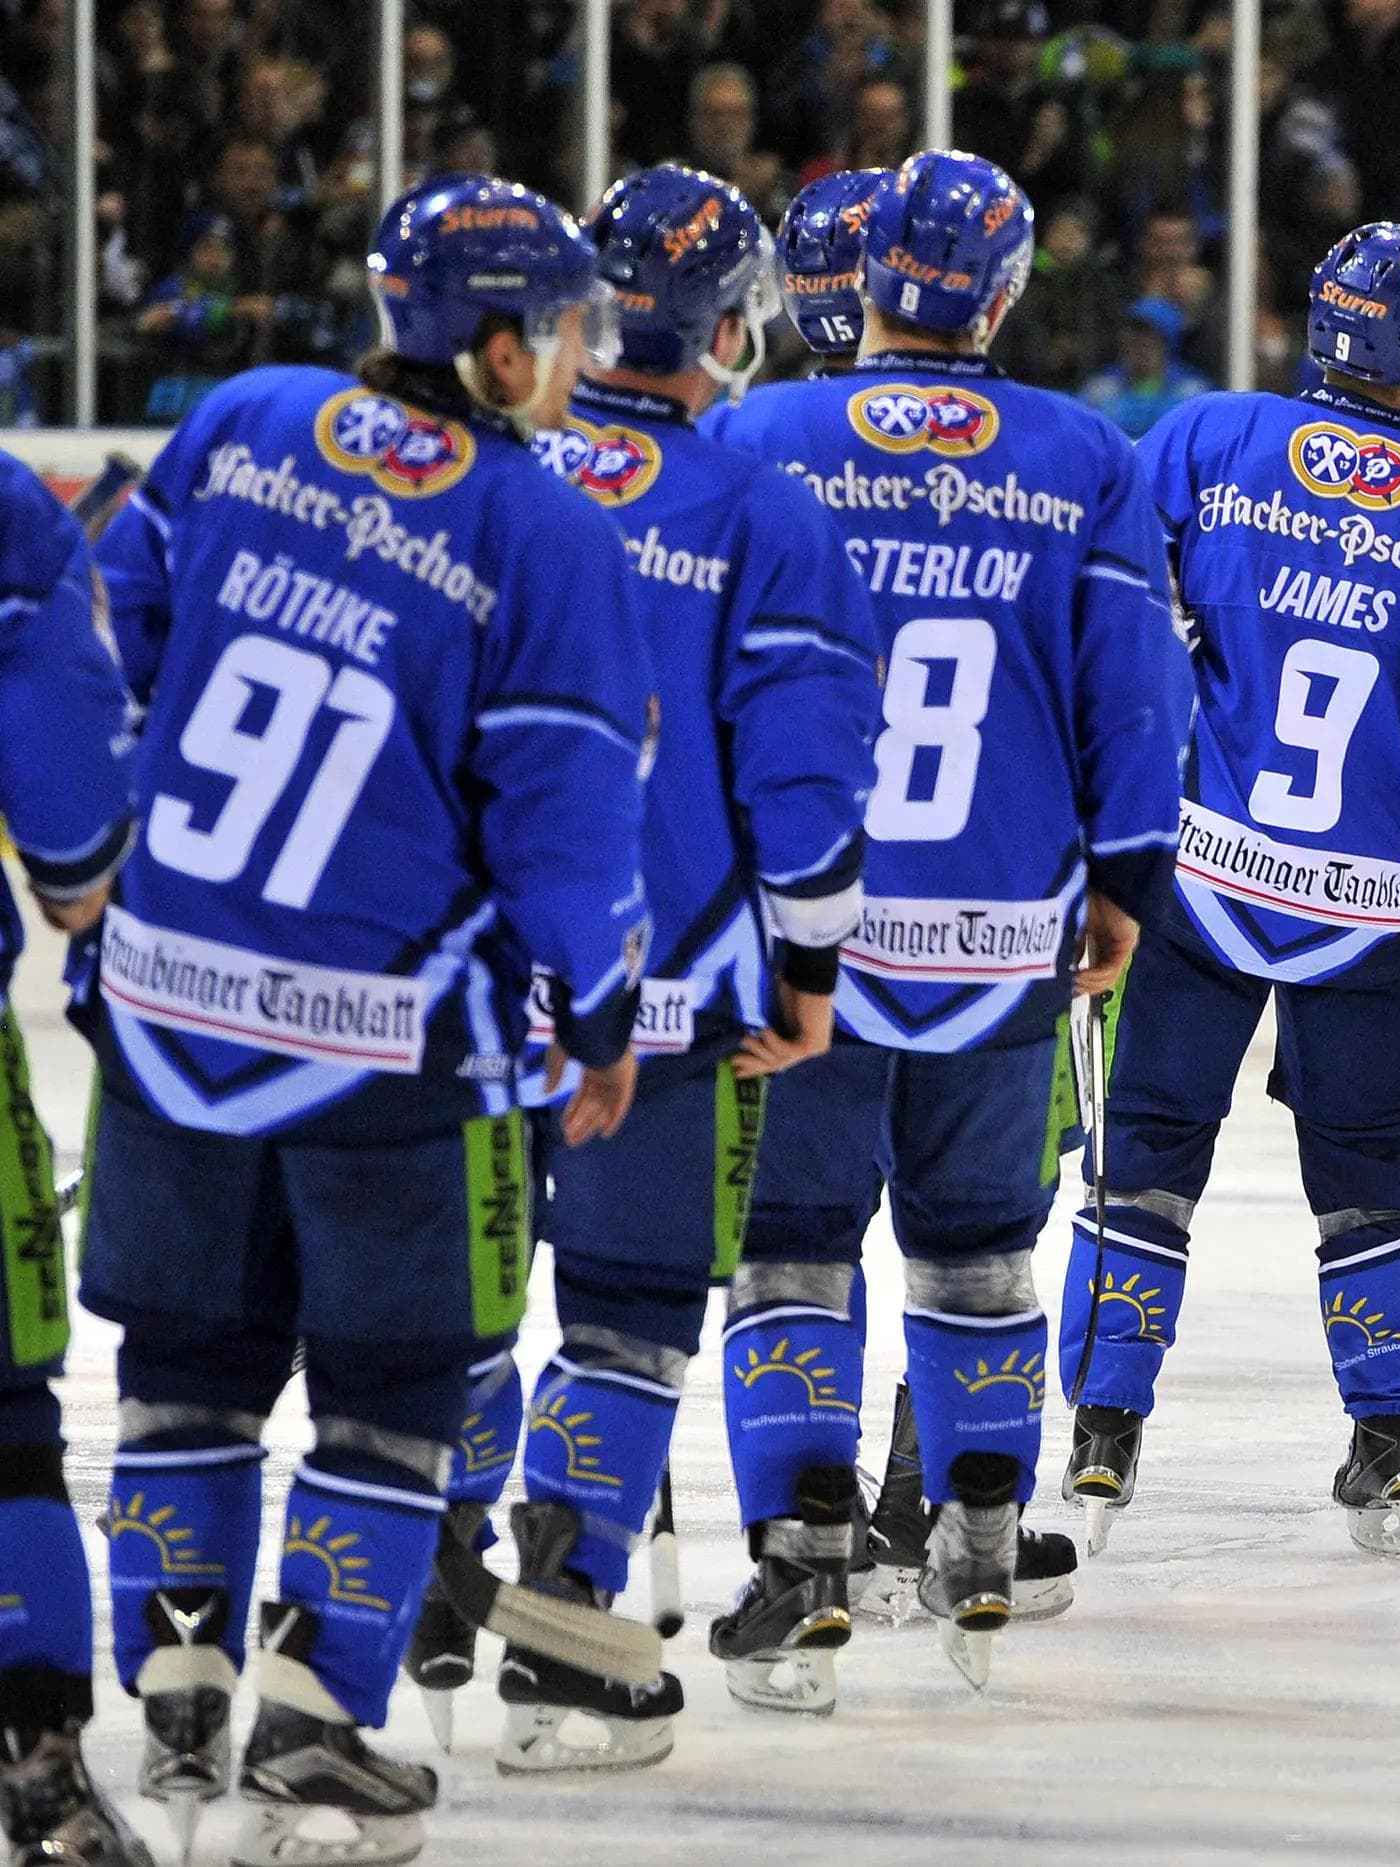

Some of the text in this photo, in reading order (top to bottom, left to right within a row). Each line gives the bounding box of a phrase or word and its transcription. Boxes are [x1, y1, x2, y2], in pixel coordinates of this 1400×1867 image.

[820, 315, 855, 343] 15
[902, 282, 920, 312] 8
[1318, 280, 1389, 320] Sturm
[1335, 332, 1351, 362] 9
[194, 441, 498, 625] Hacker-Pschor
[777, 460, 1085, 535] acker-Pschorr
[216, 549, 398, 667] RÖTHKE
[1259, 565, 1397, 633] JAMES
[864, 618, 997, 841] 8
[1248, 638, 1380, 833] 9
[1178, 807, 1319, 898] traubinger
[852, 906, 1058, 960] binger Tagblatt
[101, 922, 416, 1042] traubinger Tagblatt
